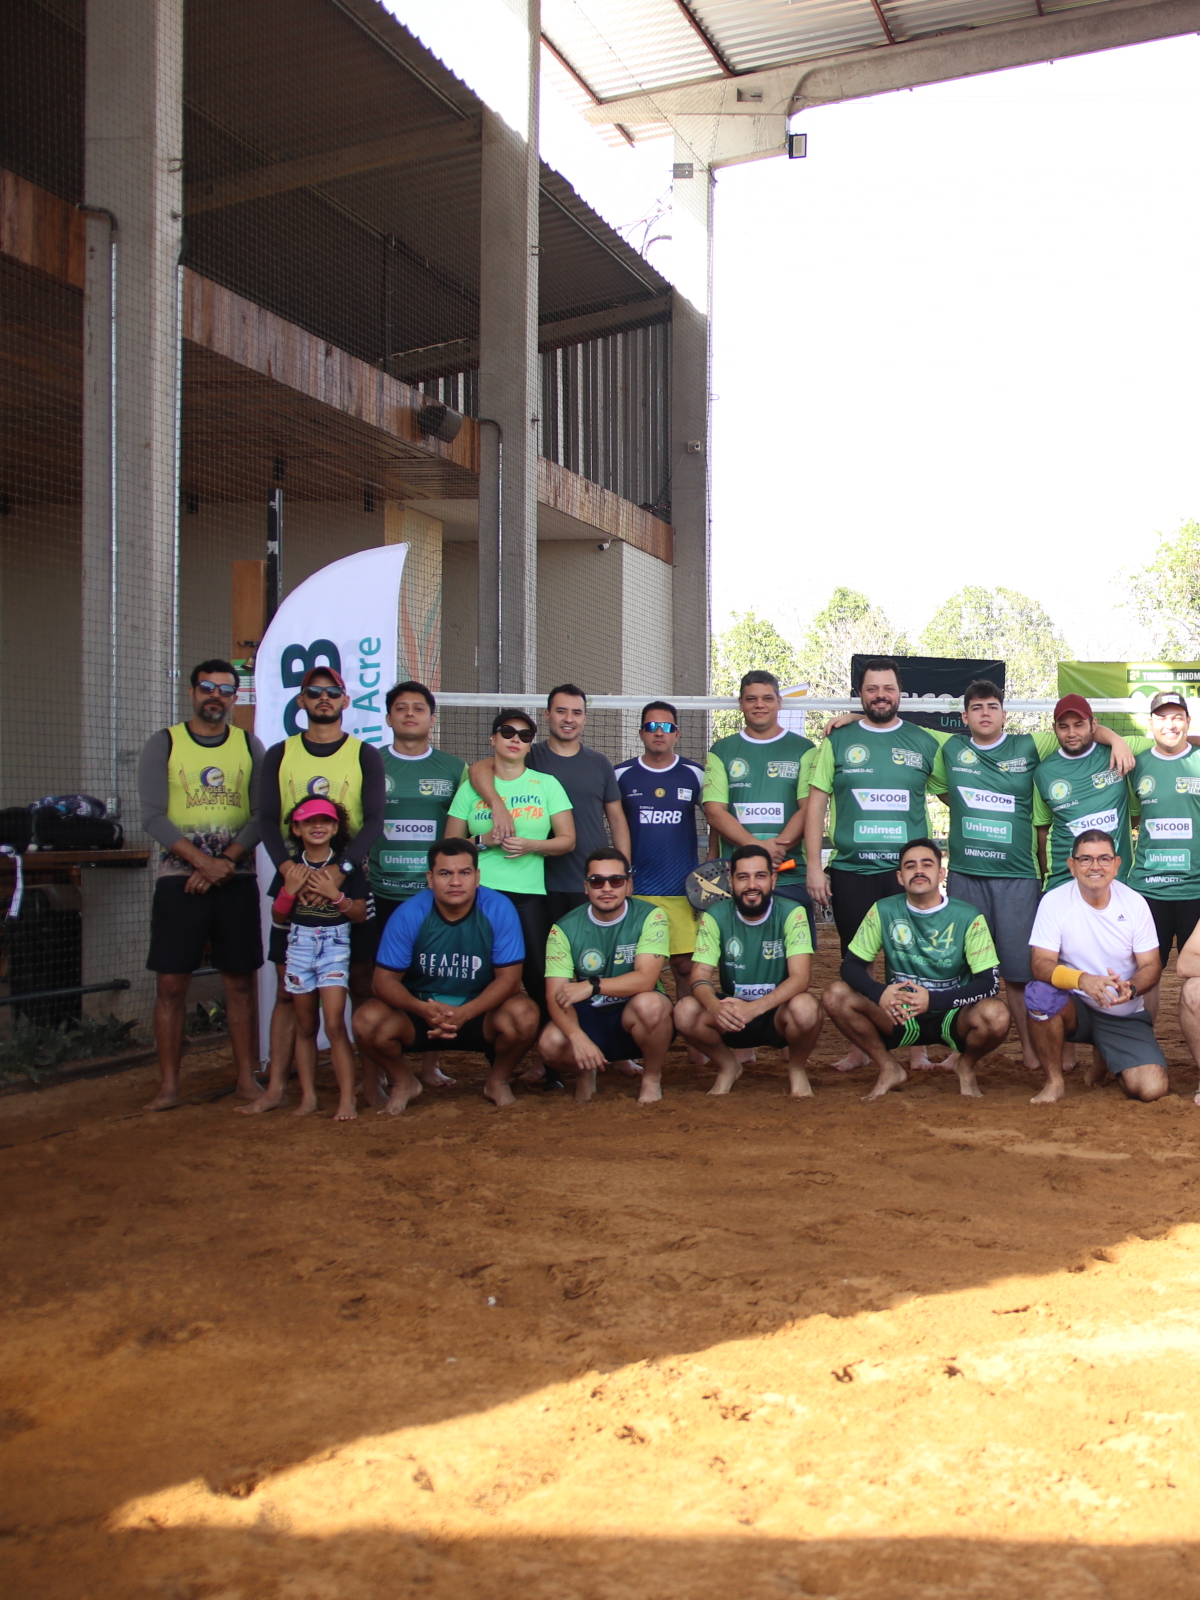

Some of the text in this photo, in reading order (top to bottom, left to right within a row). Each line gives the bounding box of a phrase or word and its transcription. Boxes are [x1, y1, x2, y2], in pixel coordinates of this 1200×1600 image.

[352, 637, 381, 713] Acre
[941, 717, 961, 727] Uni
[186, 792, 241, 809] MASTER
[511, 795, 542, 808] para
[870, 794, 907, 802] SICOOB
[975, 793, 1012, 805] SICOOB
[652, 811, 682, 824] BRB
[745, 807, 781, 816] SICOOB
[1081, 814, 1116, 829] SICOOB
[1155, 823, 1190, 831] SICOOB
[395, 825, 434, 833] SICOOB
[859, 825, 903, 834] Unimed
[966, 821, 1007, 835] Unimed
[384, 855, 427, 864] Unimed
[964, 848, 1007, 860] UNINORTE
[1149, 853, 1186, 862] Unimed
[419, 953, 469, 968] BEACH
[422, 966, 468, 979] TENNIS
